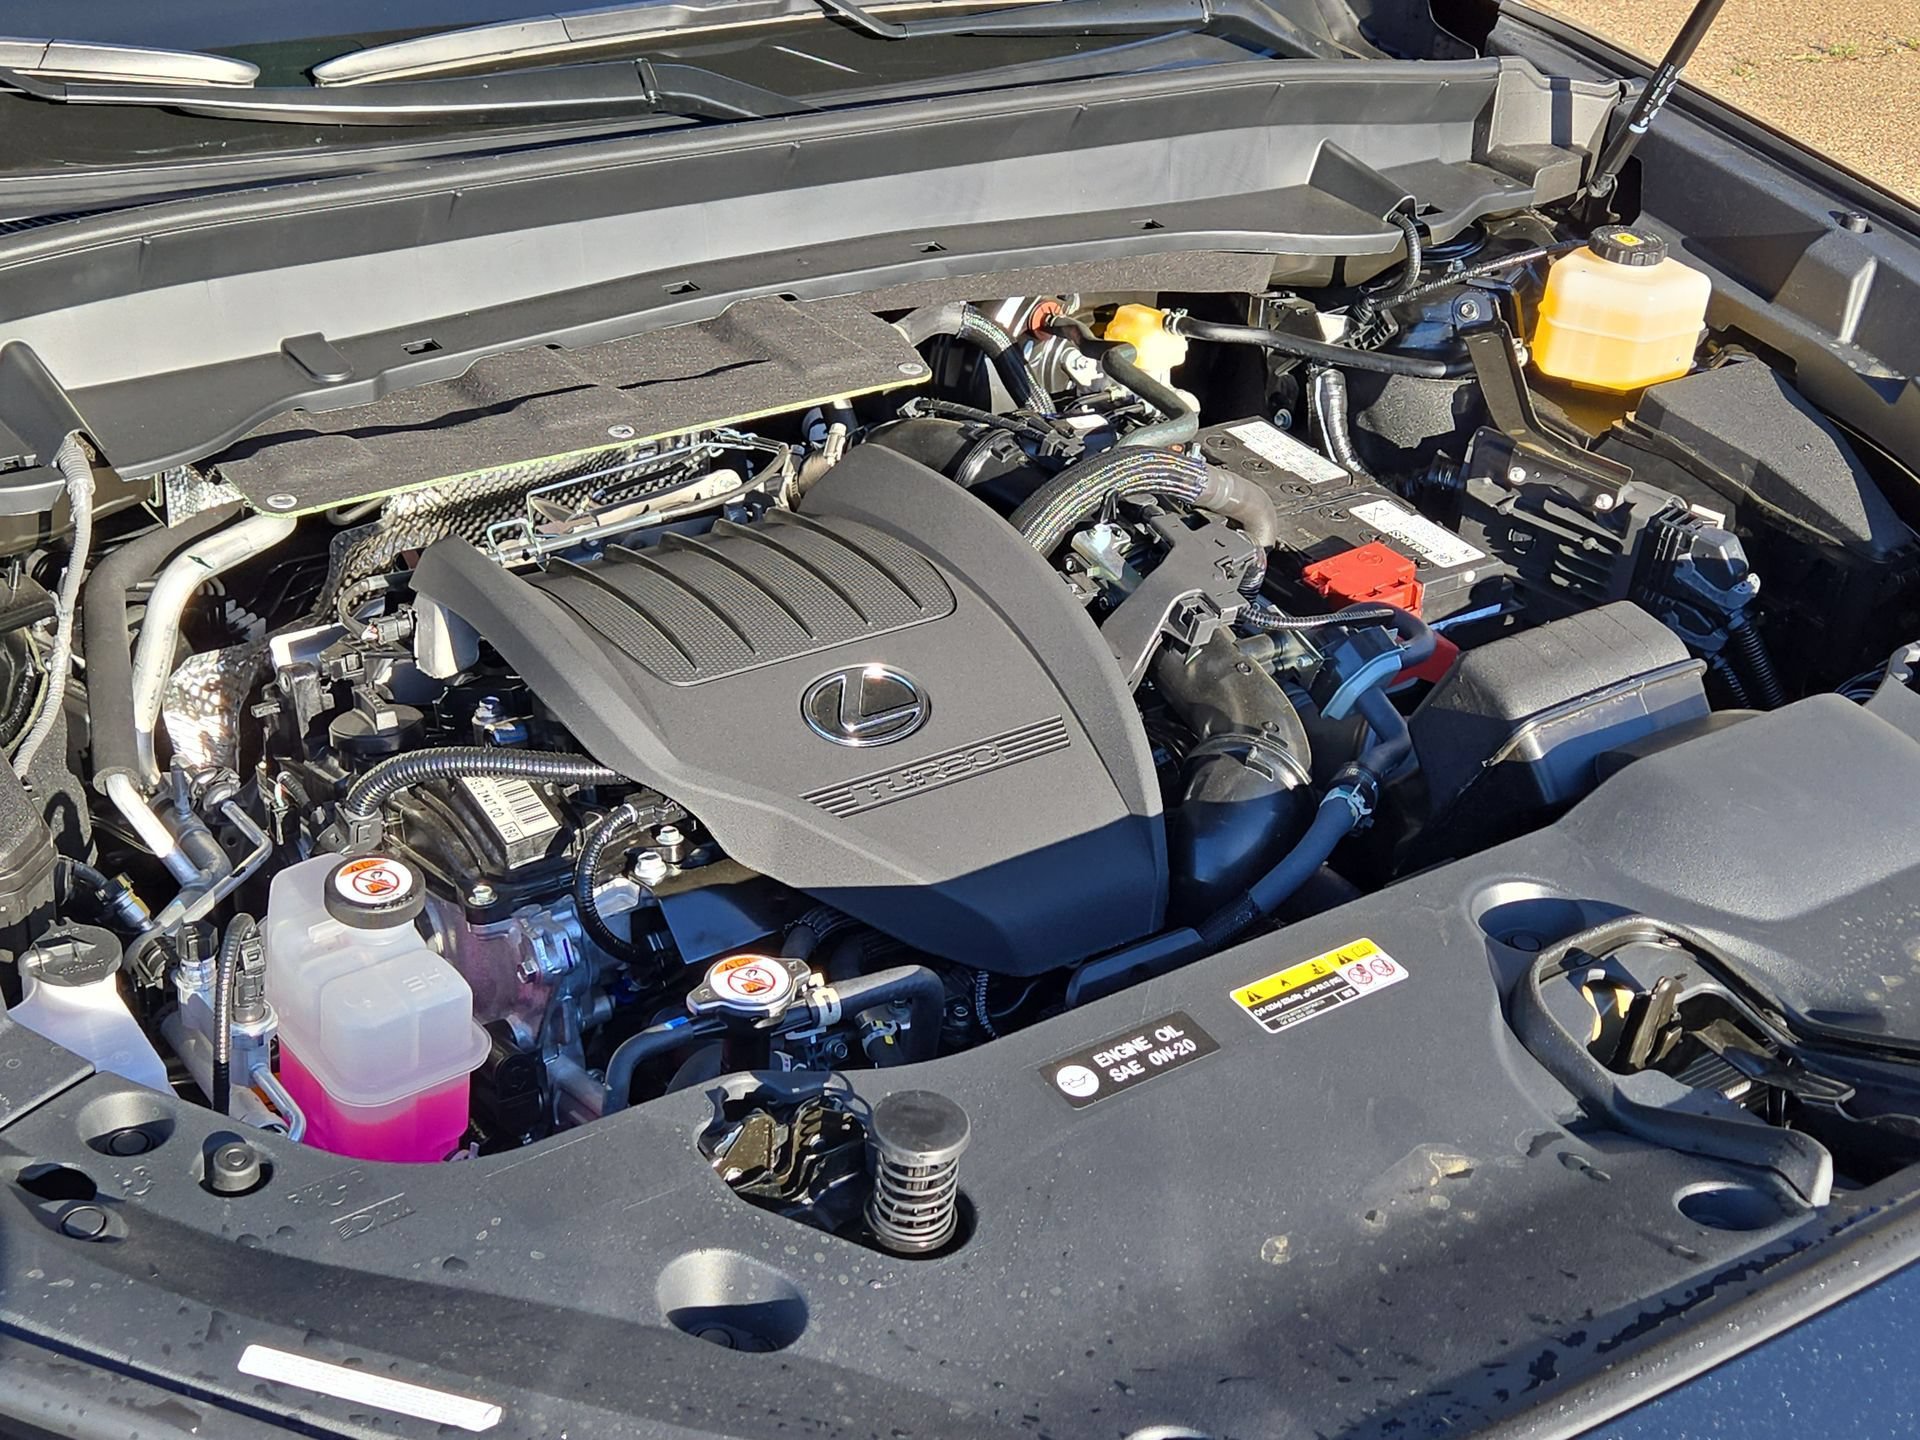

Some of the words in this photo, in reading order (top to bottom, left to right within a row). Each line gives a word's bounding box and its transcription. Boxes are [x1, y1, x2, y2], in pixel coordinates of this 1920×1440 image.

[851, 744, 1000, 800] TURBO
[1092, 1035, 1153, 1068] ENGINE
[1154, 1025, 1185, 1042] OIL
[1109, 1060, 1146, 1082] SAE
[1148, 1038, 1197, 1066] 0W-20
